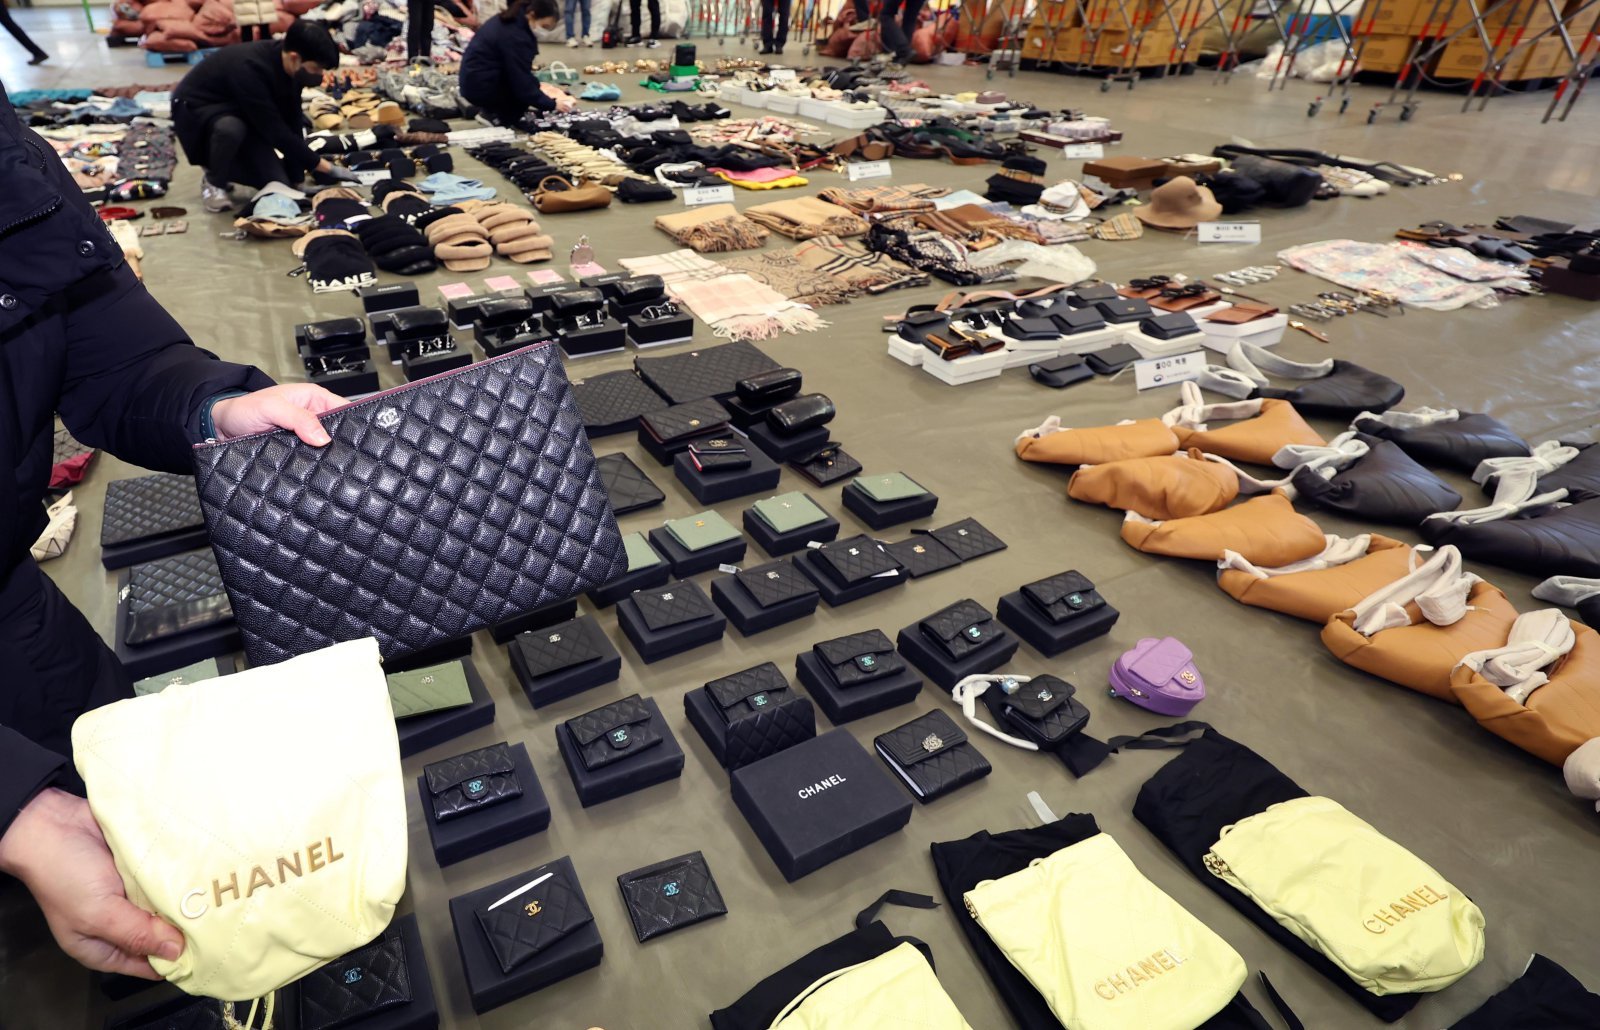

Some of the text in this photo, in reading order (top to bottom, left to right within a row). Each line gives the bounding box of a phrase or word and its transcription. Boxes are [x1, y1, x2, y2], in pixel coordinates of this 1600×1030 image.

[313, 272, 374, 288] HANE
[798, 773, 847, 799] CHANEL
[179, 836, 345, 920] CHANEL
[1362, 884, 1449, 935] CHANEL
[1094, 948, 1188, 1001] CHANEL
